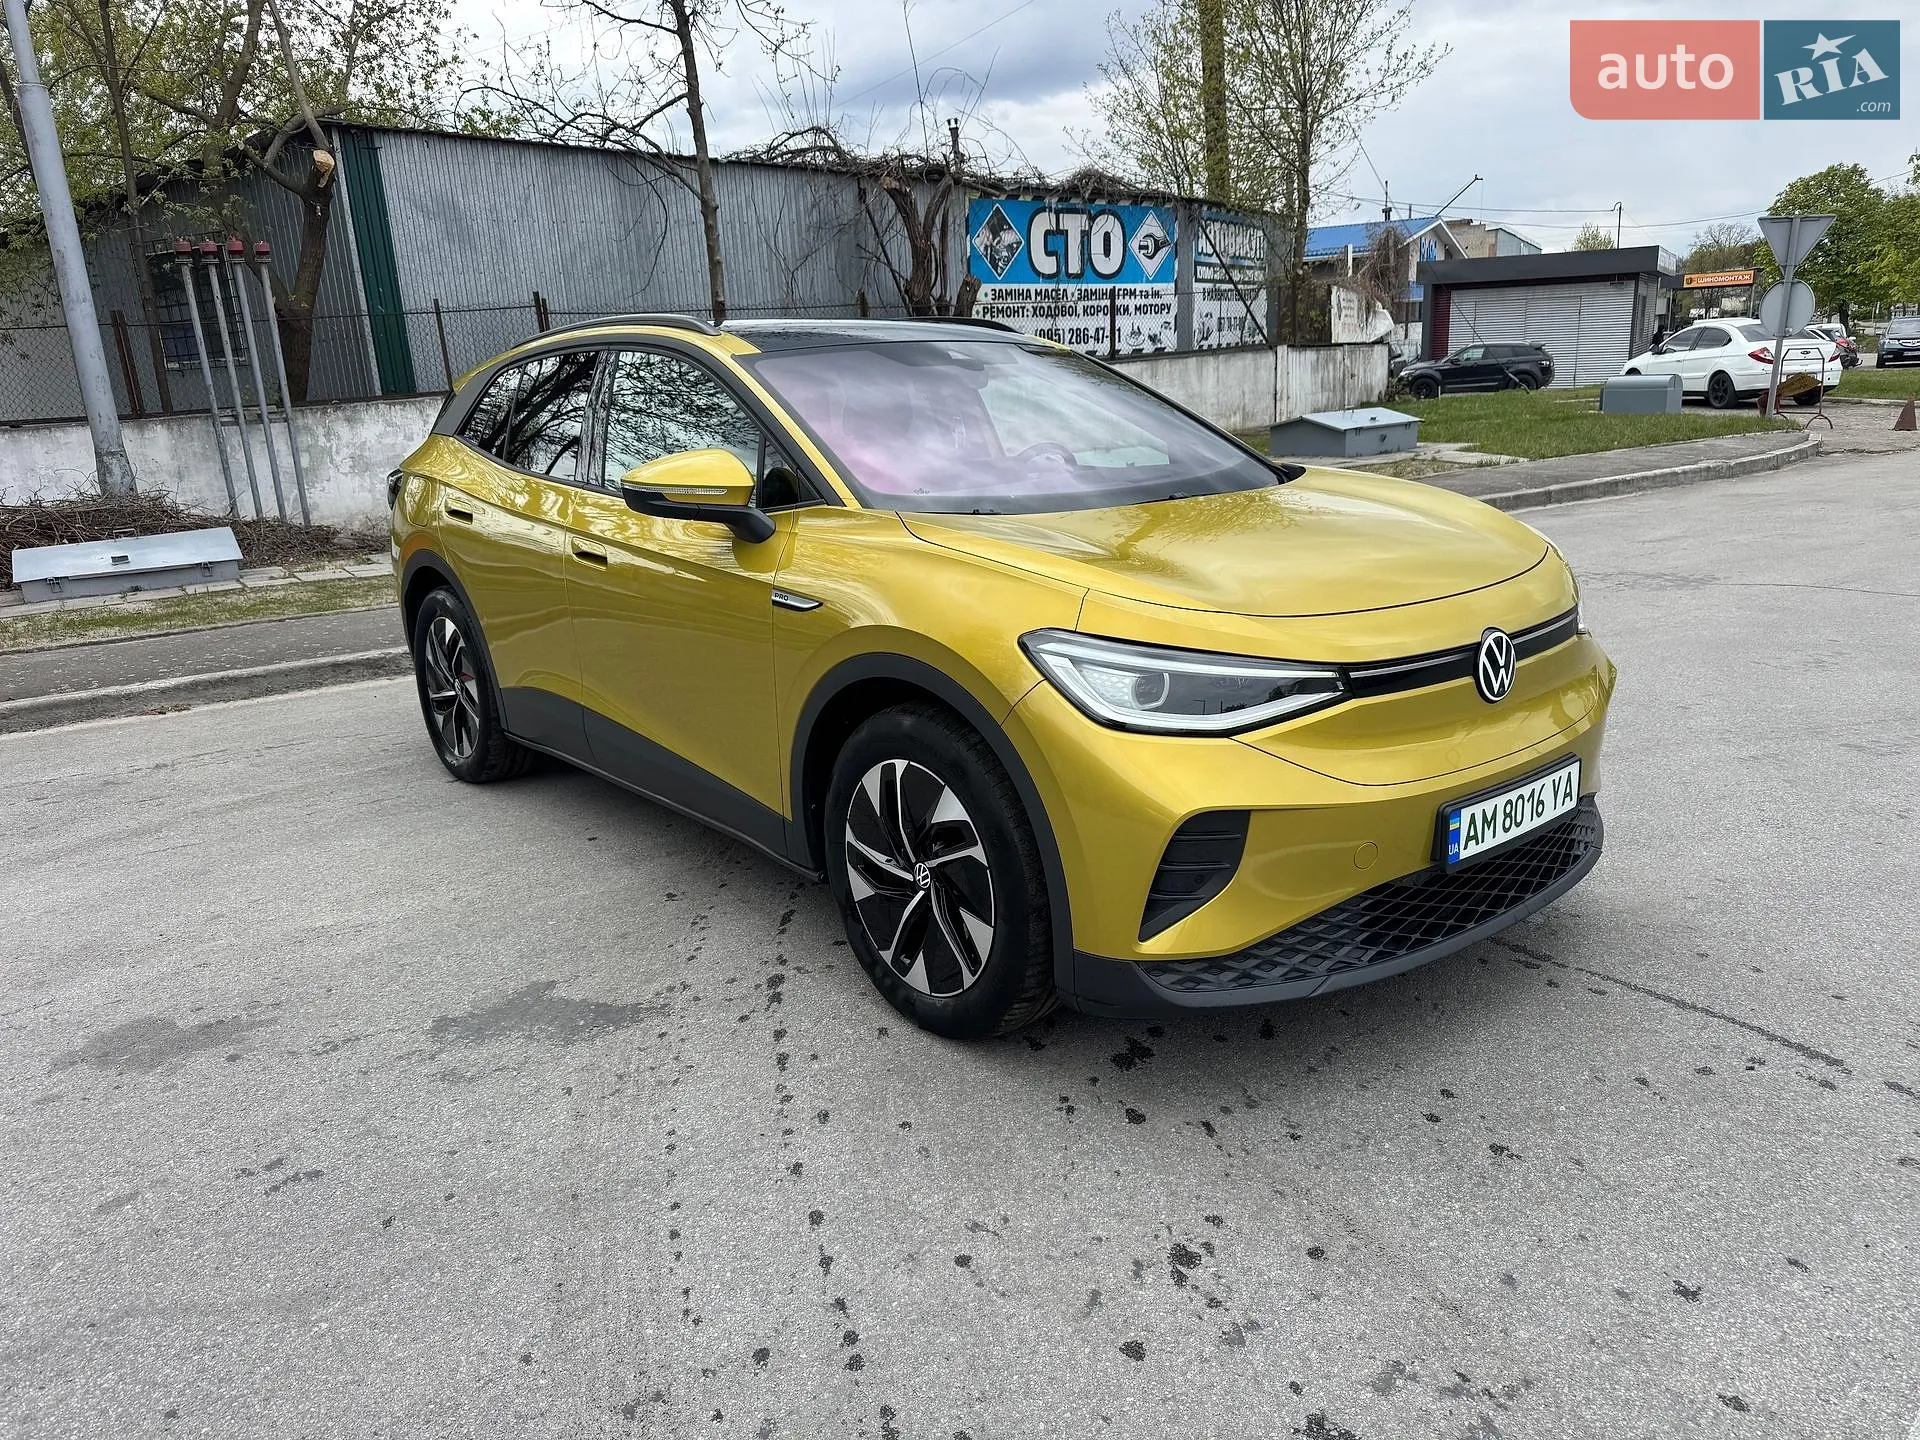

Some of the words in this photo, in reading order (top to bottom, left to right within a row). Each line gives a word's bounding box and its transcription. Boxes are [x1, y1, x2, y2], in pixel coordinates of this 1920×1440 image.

[1028, 207, 1125, 279] СТО
[1697, 274, 1751, 283] ШИНОМОНТАЖ
[990, 288, 1032, 301] ЗАМІНА
[1034, 288, 1069, 301] МАСЕЛ
[1117, 287, 1137, 300] ГРМ
[982, 305, 1030, 319] РЕМОНТ:
[1031, 302, 1080, 319] ХОДОВОЇ,
[1082, 303, 1132, 317] КОРОКИ,
[1134, 303, 1172, 316] МОТОРУ
[1068, 326, 1121, 345] 286-47-1
[774, 592, 789, 601] PRO
[1463, 803, 1497, 850] AM
[1502, 782, 1545, 833] 8016
[1552, 770, 1574, 810] YA
[1449, 844, 1460, 856] UA
